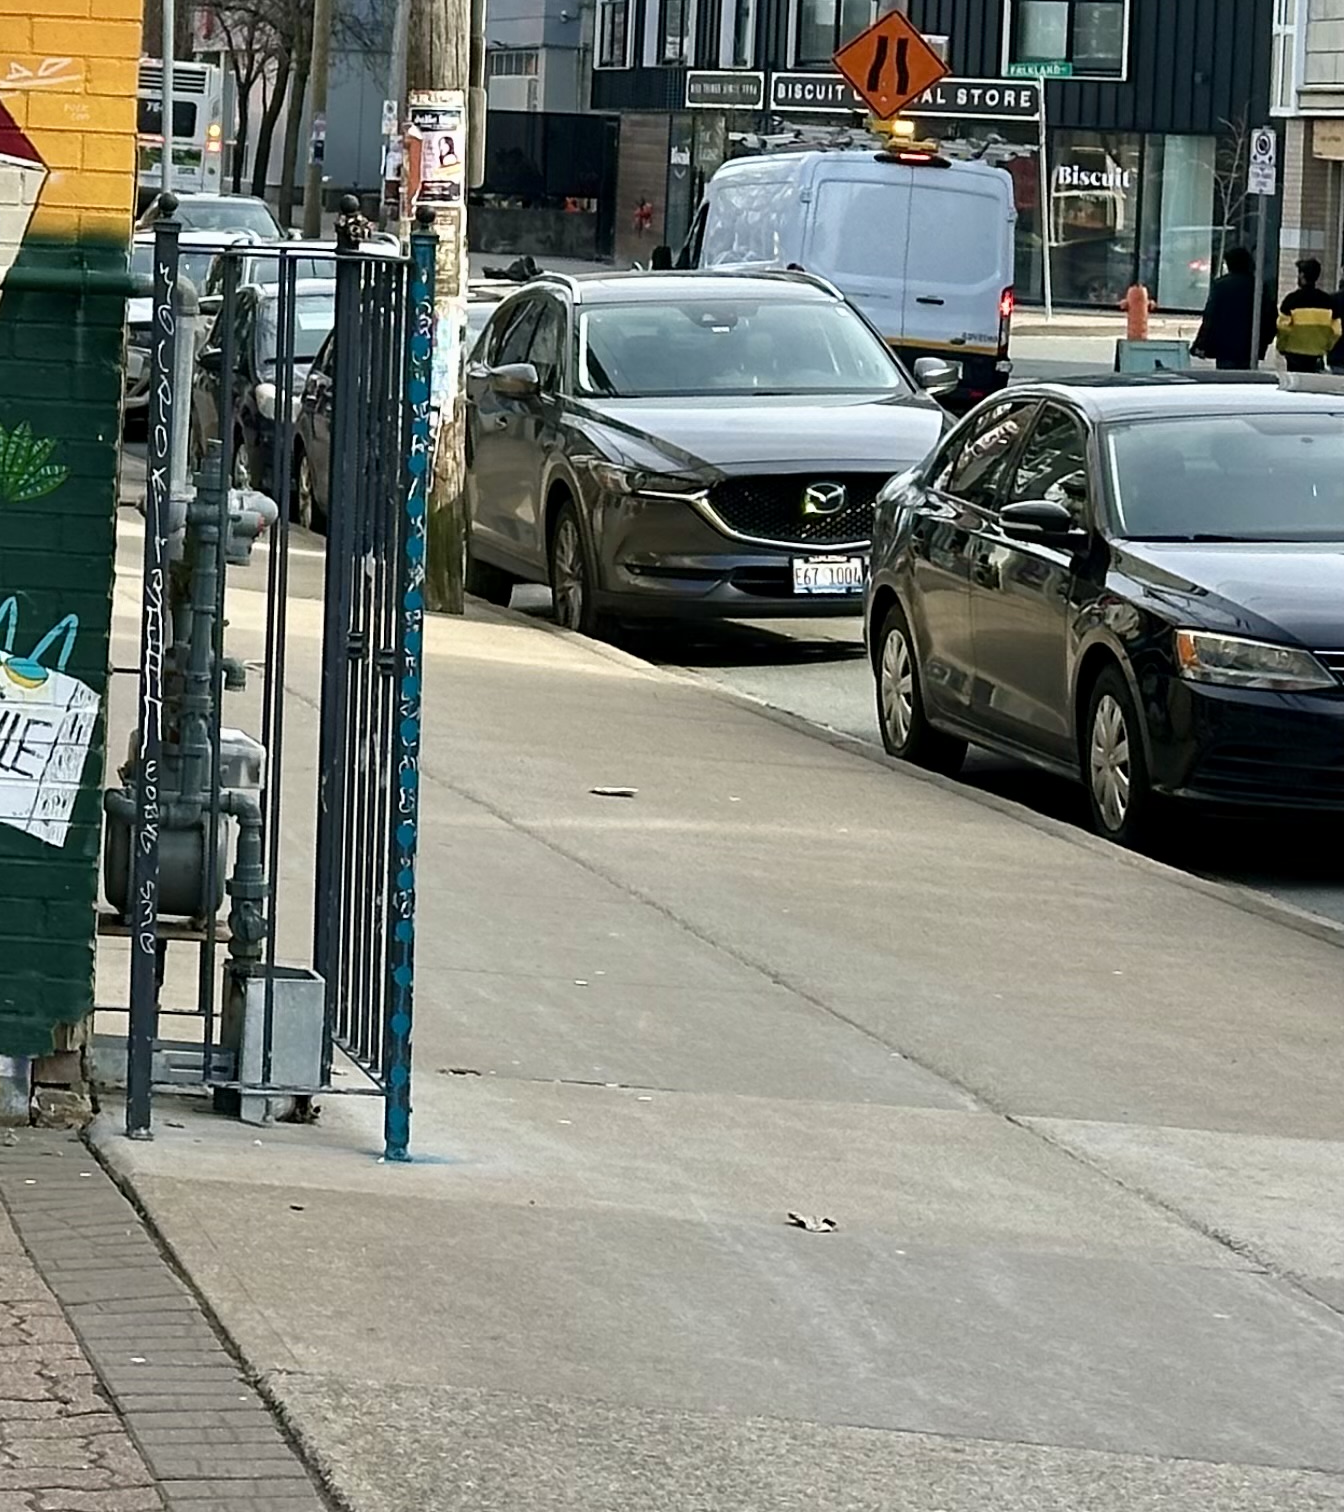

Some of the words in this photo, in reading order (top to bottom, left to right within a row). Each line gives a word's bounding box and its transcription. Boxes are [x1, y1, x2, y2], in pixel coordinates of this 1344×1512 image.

[777, 83, 845, 101] BISCUIT
[956, 87, 1032, 107] STORE
[1058, 165, 1130, 187] Biscuit
